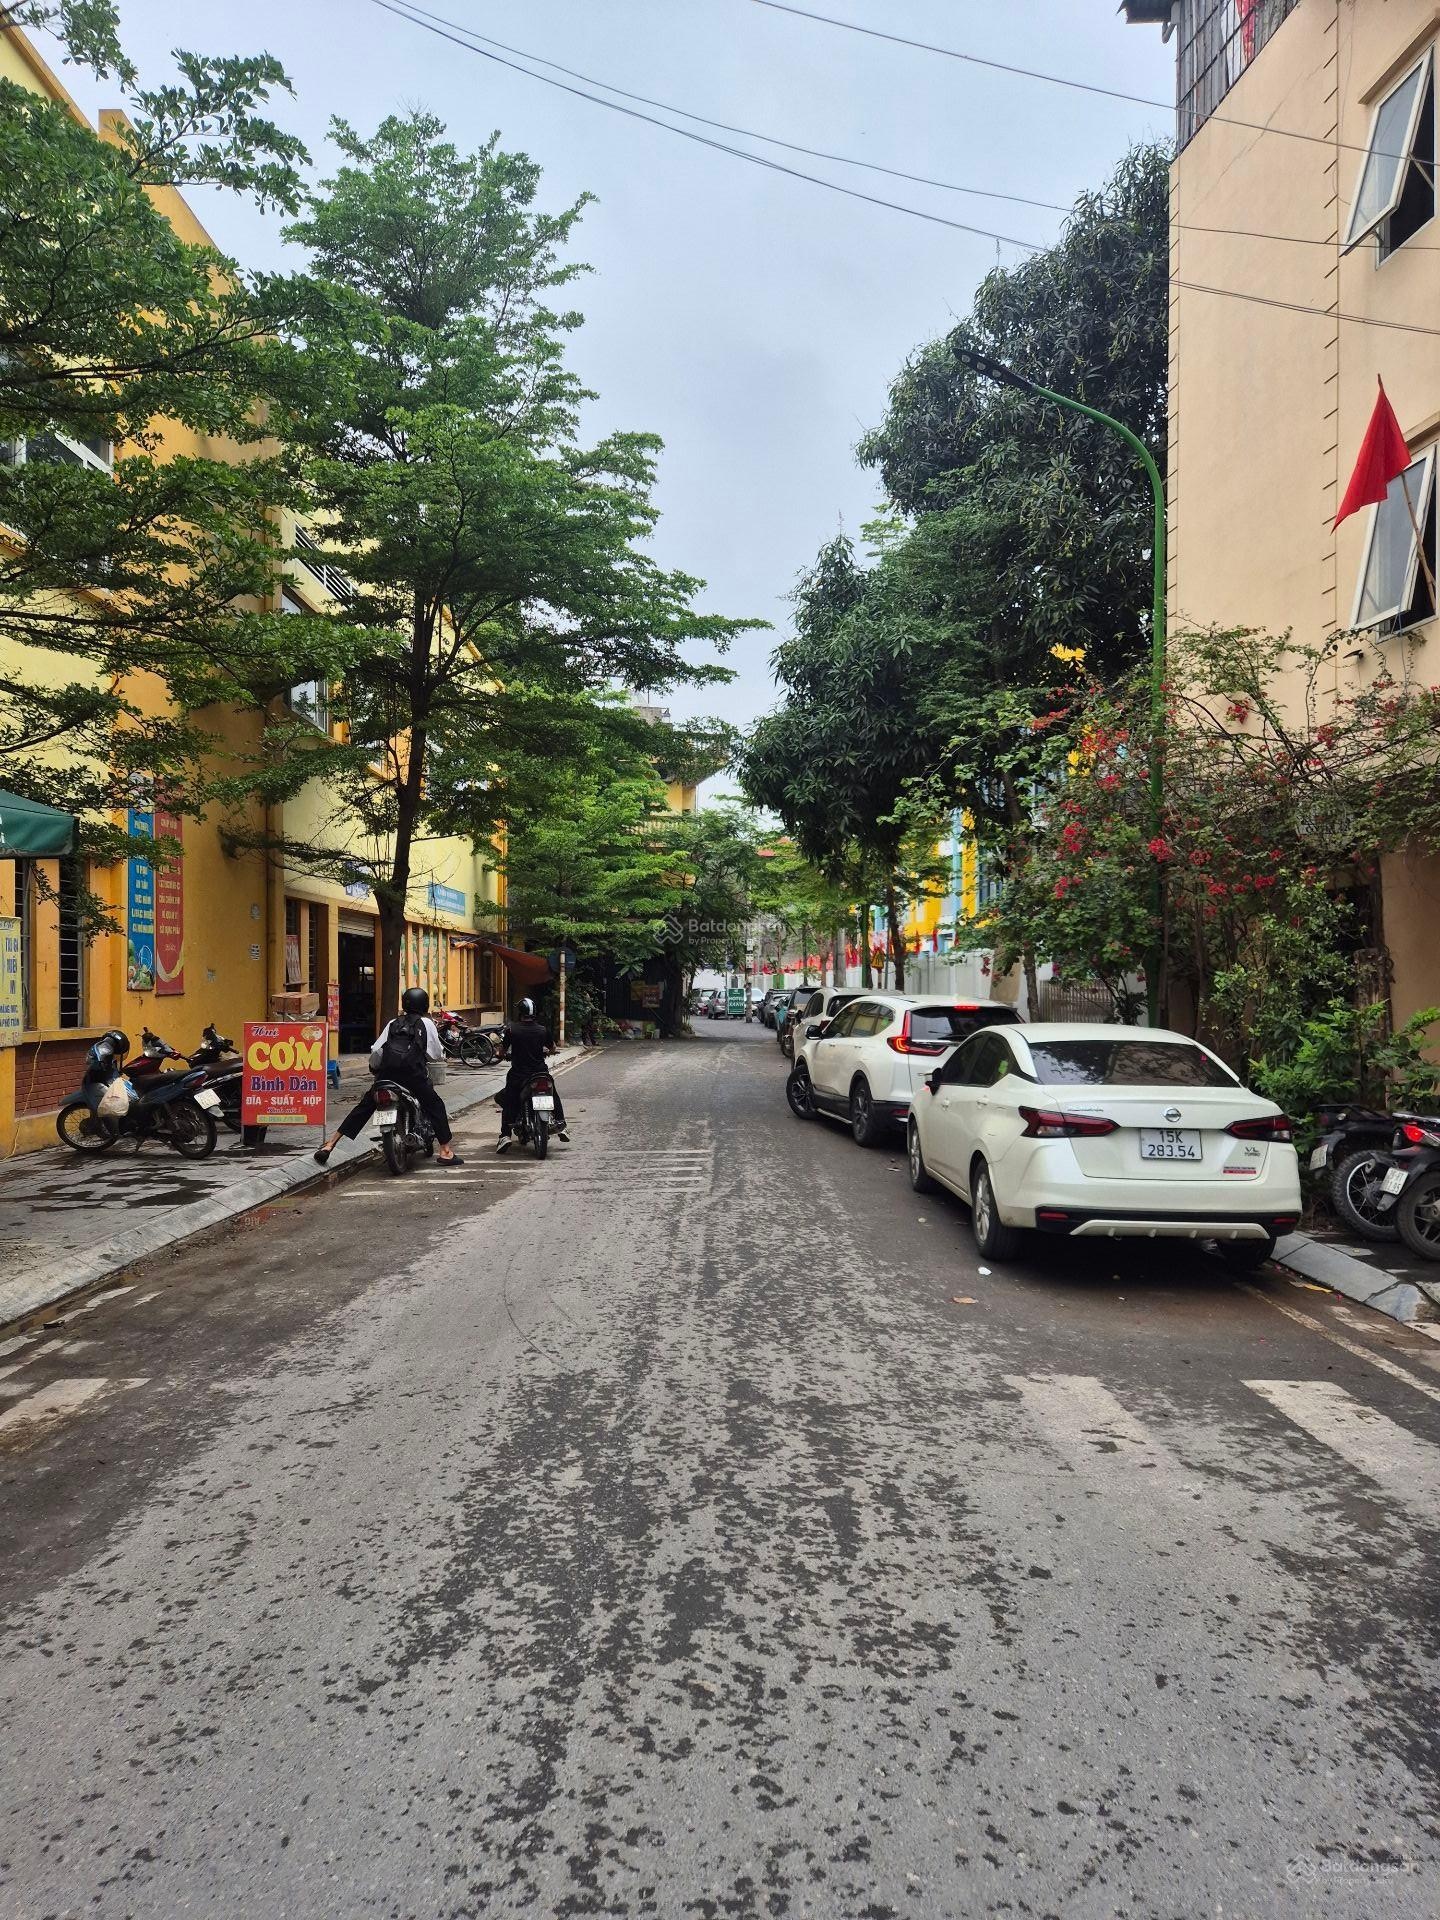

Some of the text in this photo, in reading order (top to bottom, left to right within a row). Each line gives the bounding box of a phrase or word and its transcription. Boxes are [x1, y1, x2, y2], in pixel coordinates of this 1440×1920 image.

[247, 1036, 323, 1071] CƠM
[251, 1076, 317, 1092] Bình Dân
[271, 1094, 294, 1105] SUẤT
[303, 1095, 322, 1107] HỘP
[1160, 1130, 1183, 1143] 15K
[1148, 1145, 1196, 1158] 283.54
